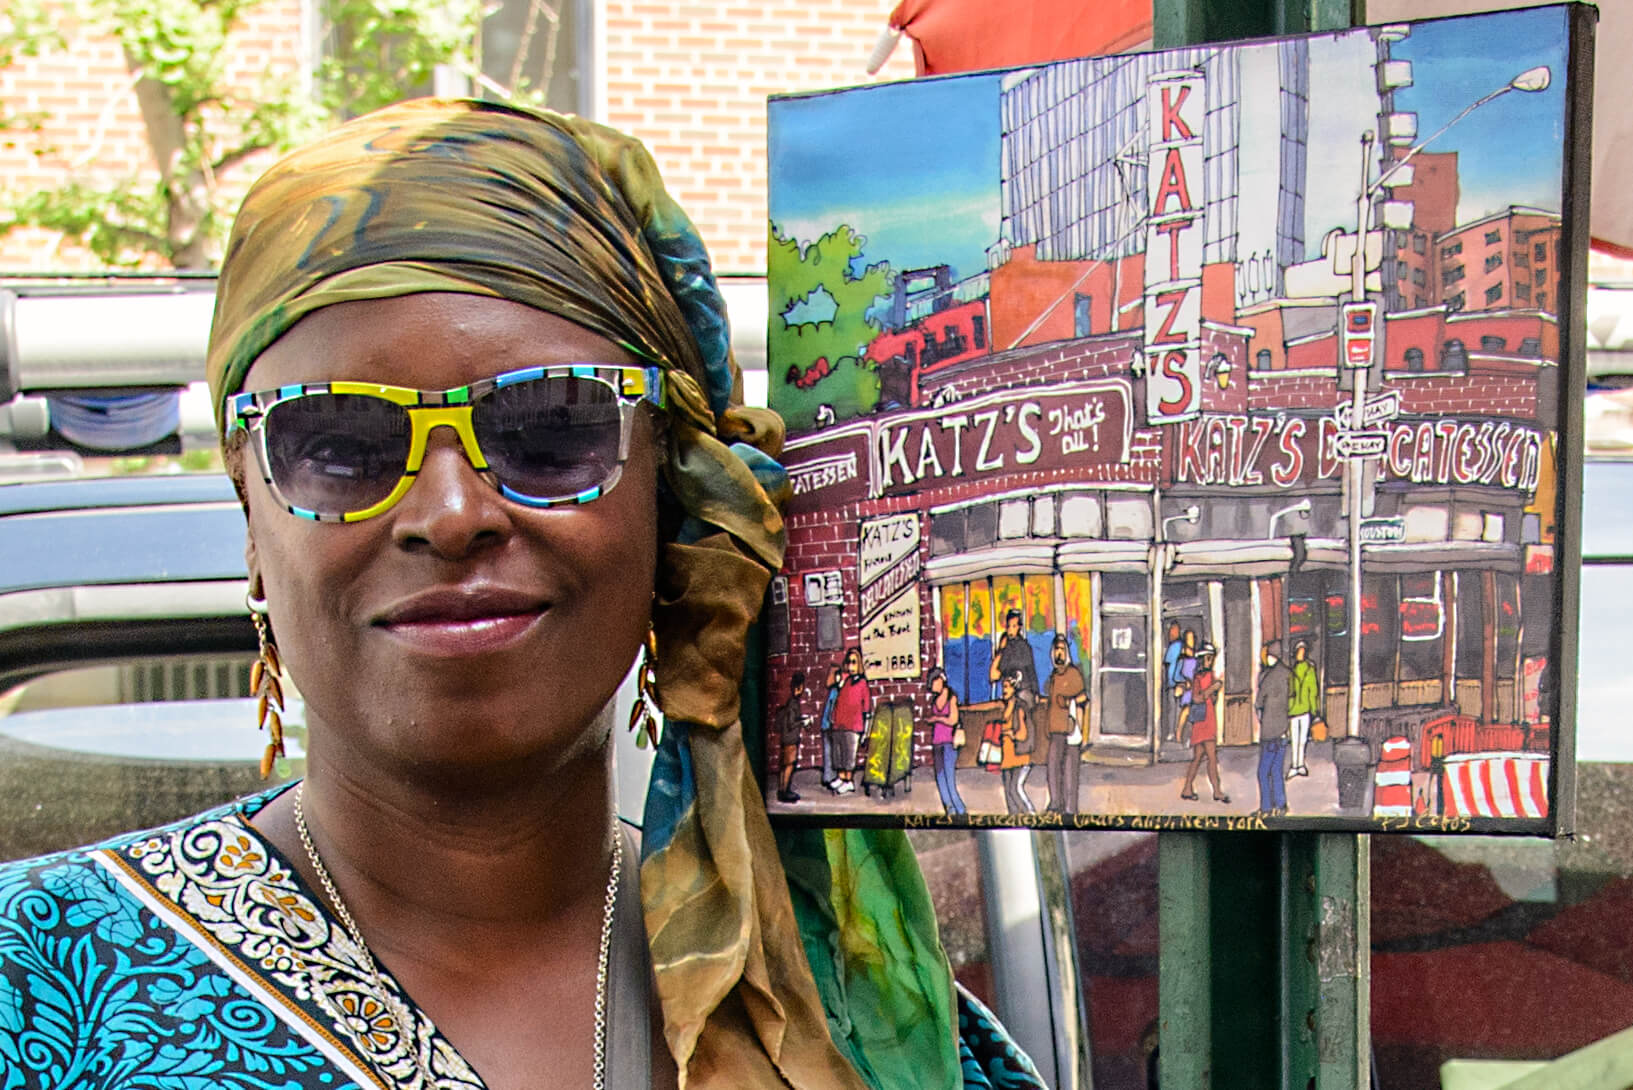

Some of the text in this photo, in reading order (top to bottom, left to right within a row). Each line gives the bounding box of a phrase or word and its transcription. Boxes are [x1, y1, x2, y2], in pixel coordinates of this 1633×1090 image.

[1150, 85, 1193, 416] KATZ'S
[880, 402, 1044, 487] KATZ'S
[1048, 397, 1106, 436] That's
[789, 456, 858, 496] ATESSEN
[1177, 412, 1544, 492] KATZ'S DCATESSEN
[861, 517, 914, 552] KATZ'S
